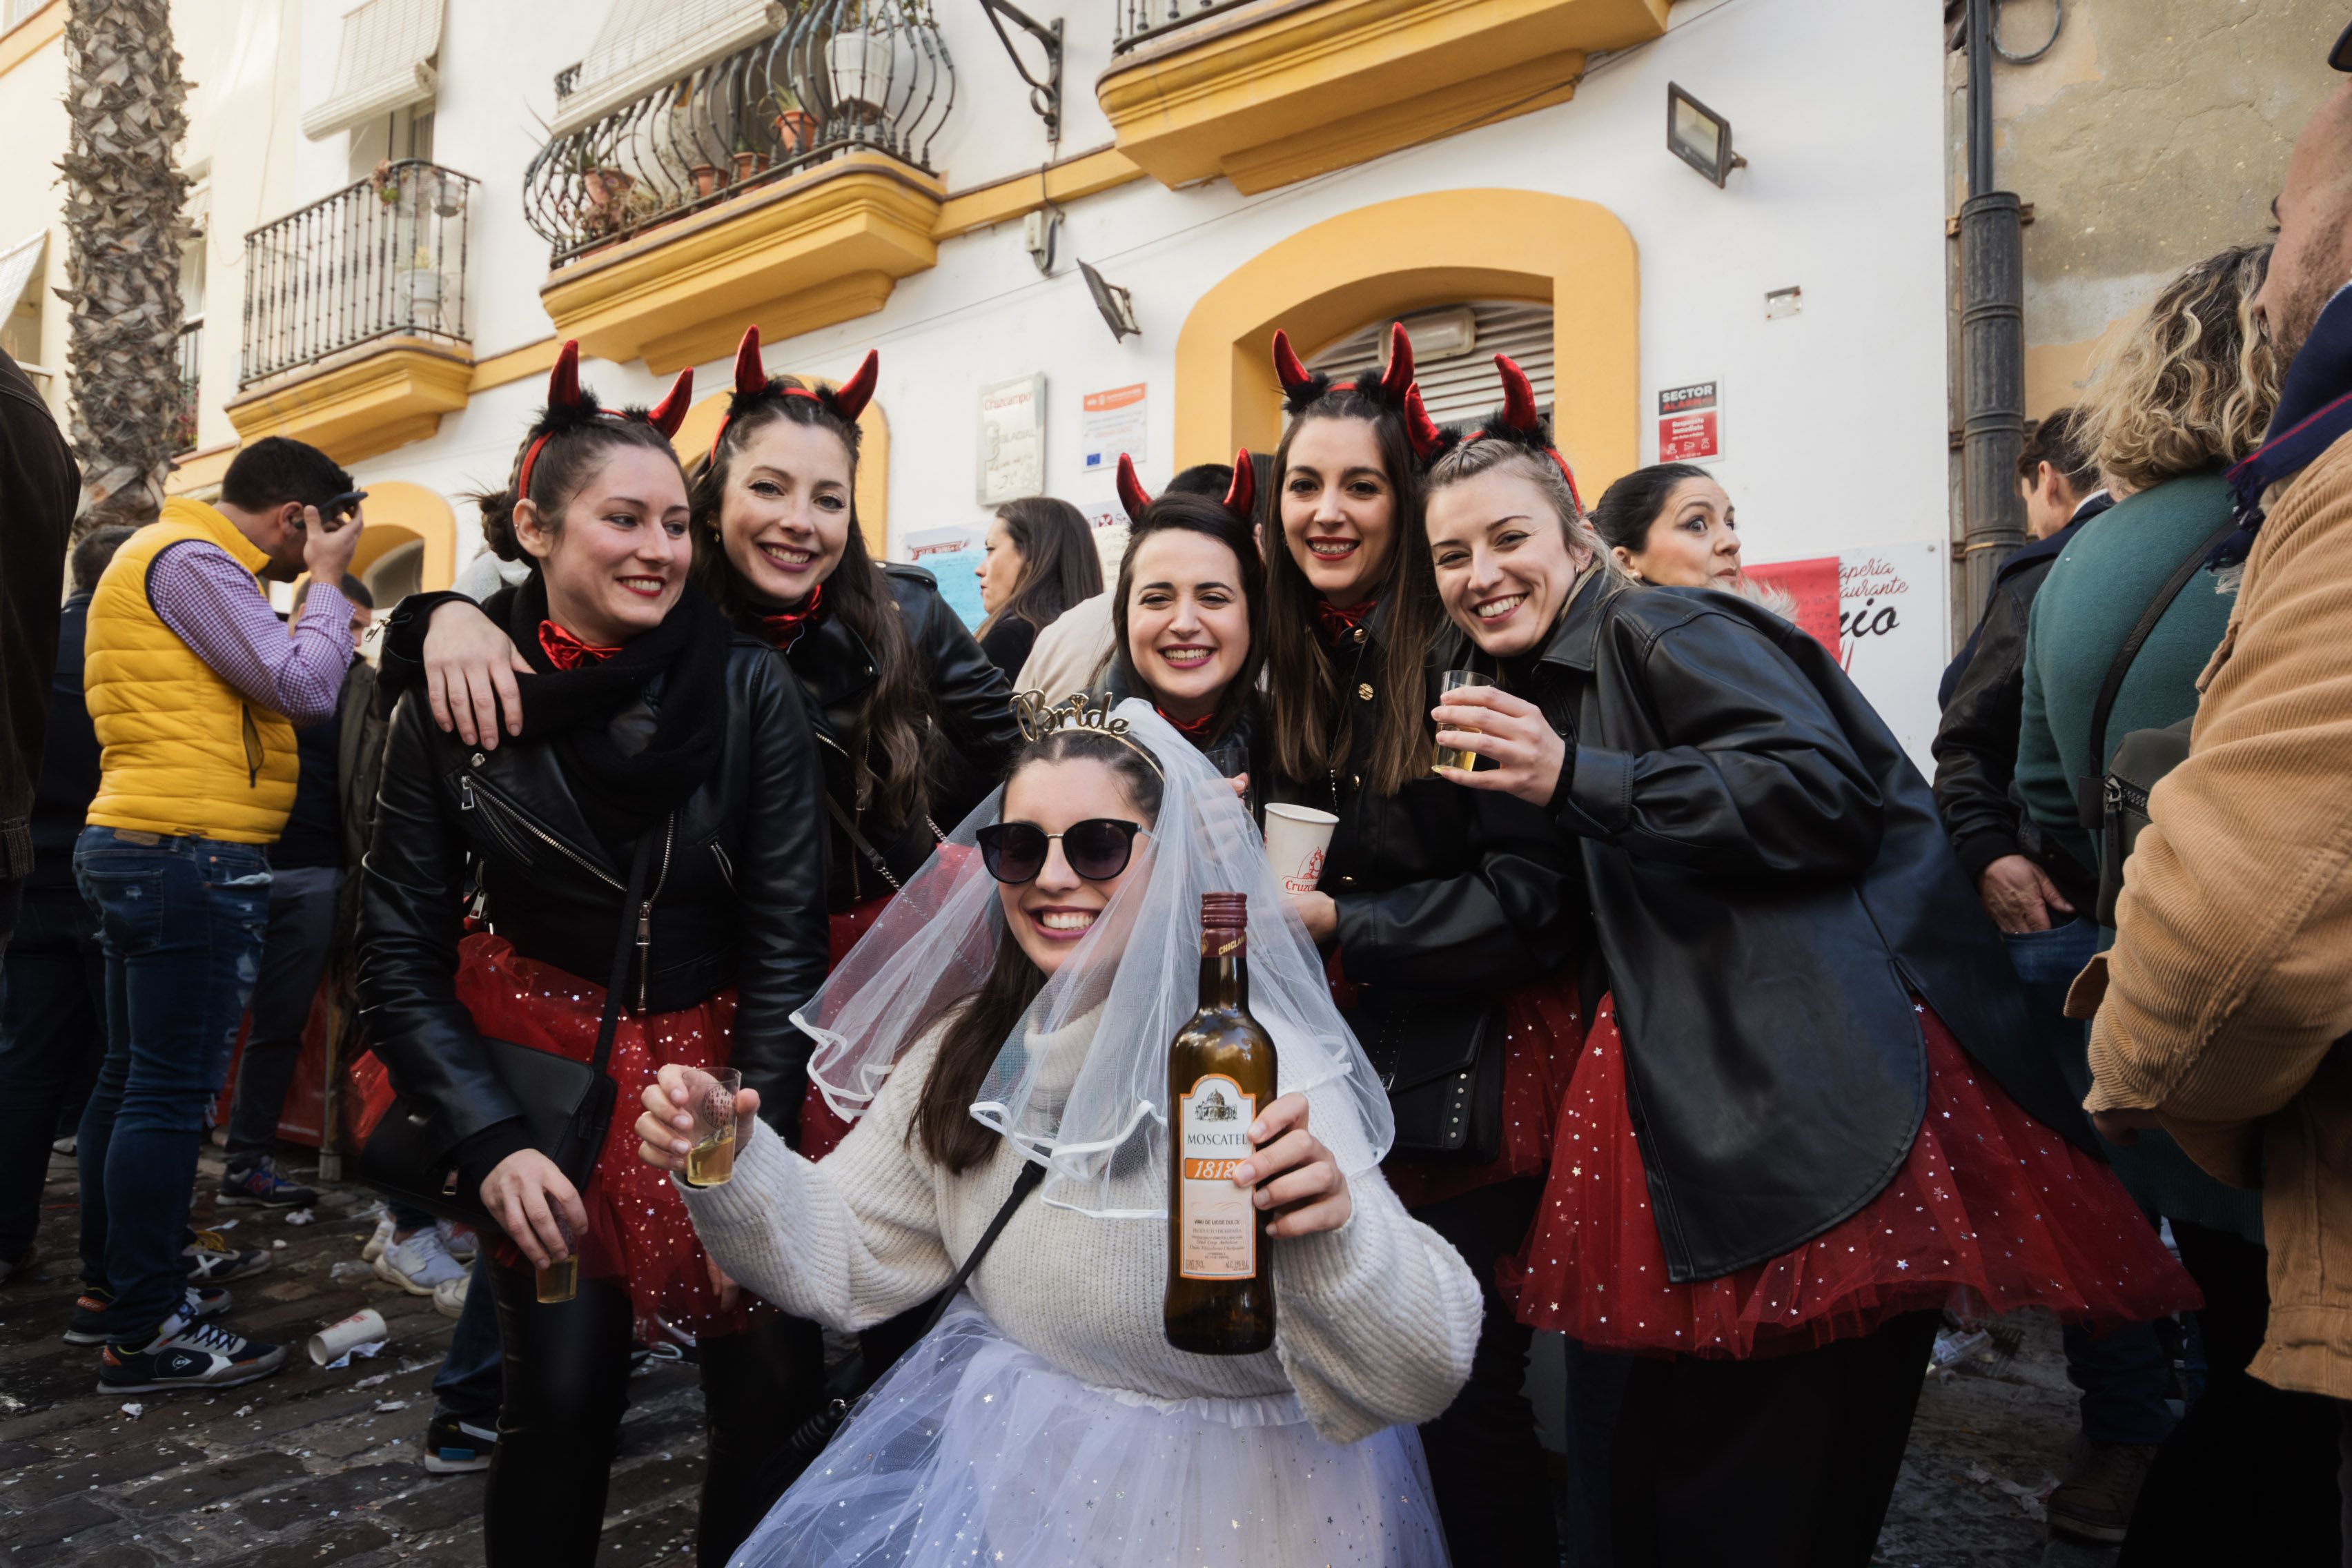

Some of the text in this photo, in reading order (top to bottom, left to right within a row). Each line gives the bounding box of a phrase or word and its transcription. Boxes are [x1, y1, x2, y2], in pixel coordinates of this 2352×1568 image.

[984, 392, 1032, 411] Cruzcampo
[1663, 385, 1713, 402] SECTOR
[1839, 576, 1910, 598] aurante
[1008, 688, 1130, 742] Bride
[1187, 1133, 1248, 1146] MOSCATEL
[1194, 1160, 1236, 1179] 1812
